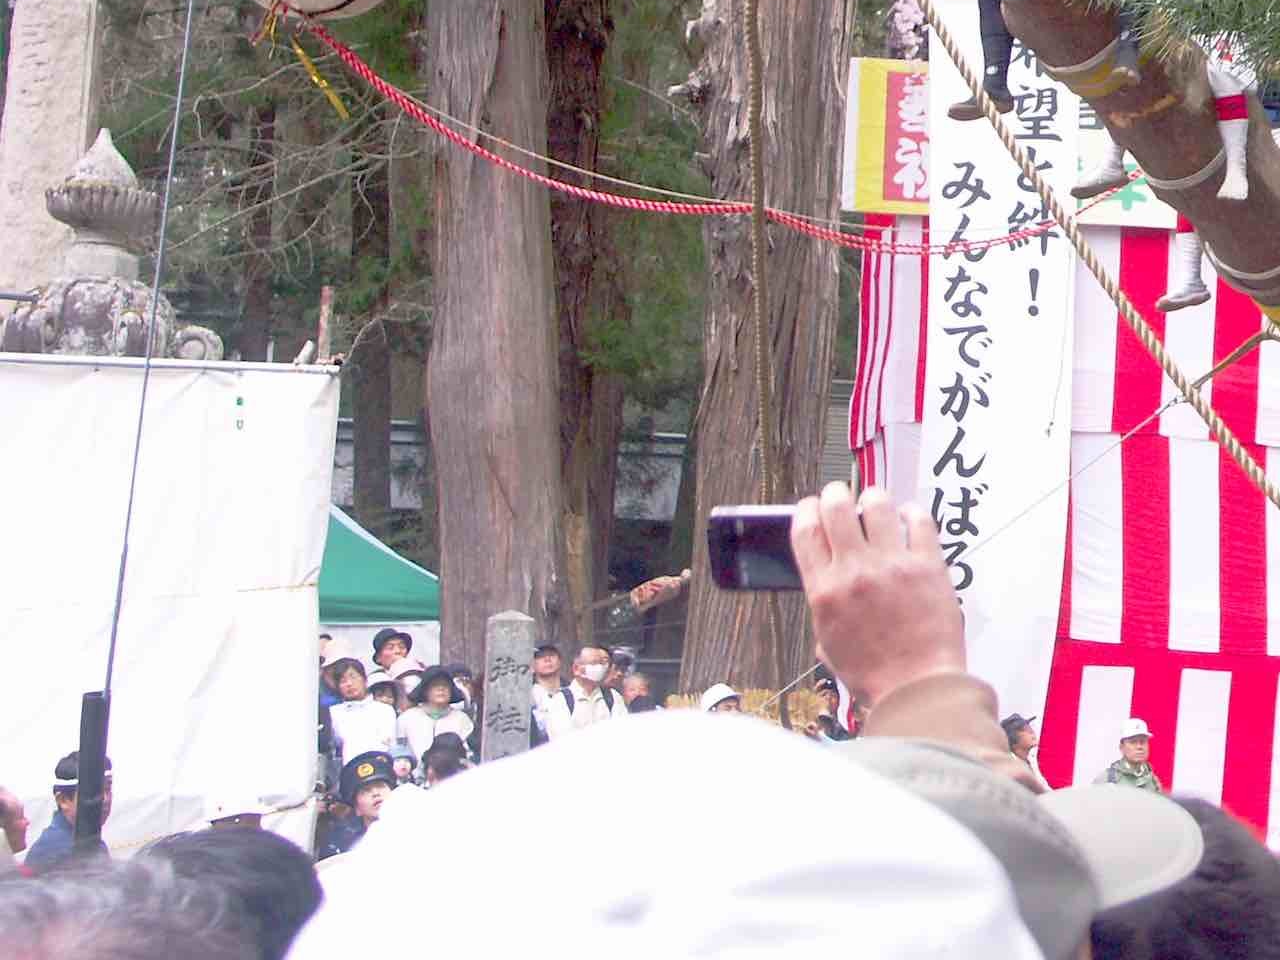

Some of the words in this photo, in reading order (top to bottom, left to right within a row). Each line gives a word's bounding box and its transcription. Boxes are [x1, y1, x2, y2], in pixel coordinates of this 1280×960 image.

[930, 161, 992, 630] みんなでがんばろ
[486, 656, 530, 759] 御柱
